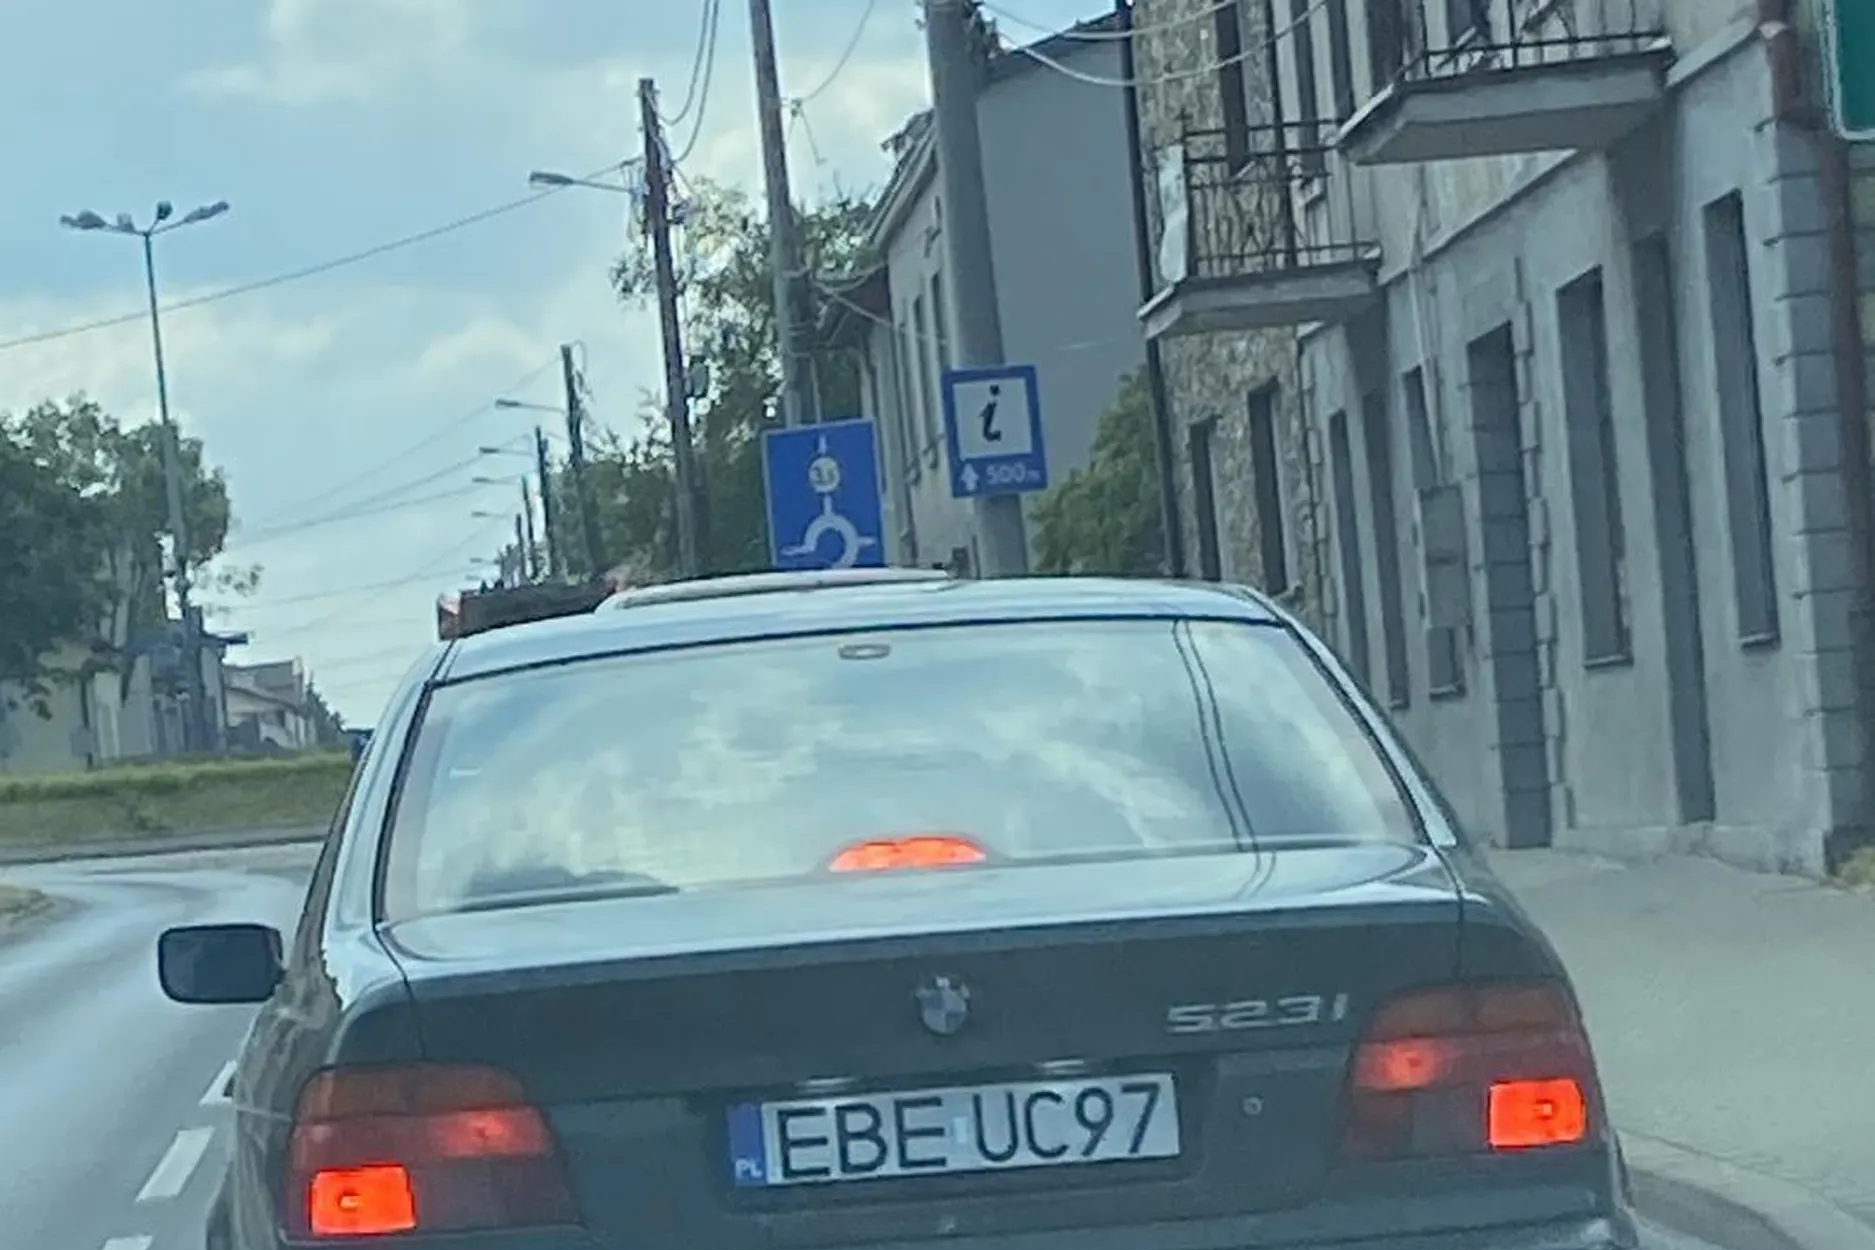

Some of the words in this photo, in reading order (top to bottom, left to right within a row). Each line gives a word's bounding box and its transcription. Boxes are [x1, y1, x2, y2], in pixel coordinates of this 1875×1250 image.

[776, 1096, 948, 1179] EBE
[972, 1083, 1161, 1163] UC97
[735, 1159, 763, 1179] PL
